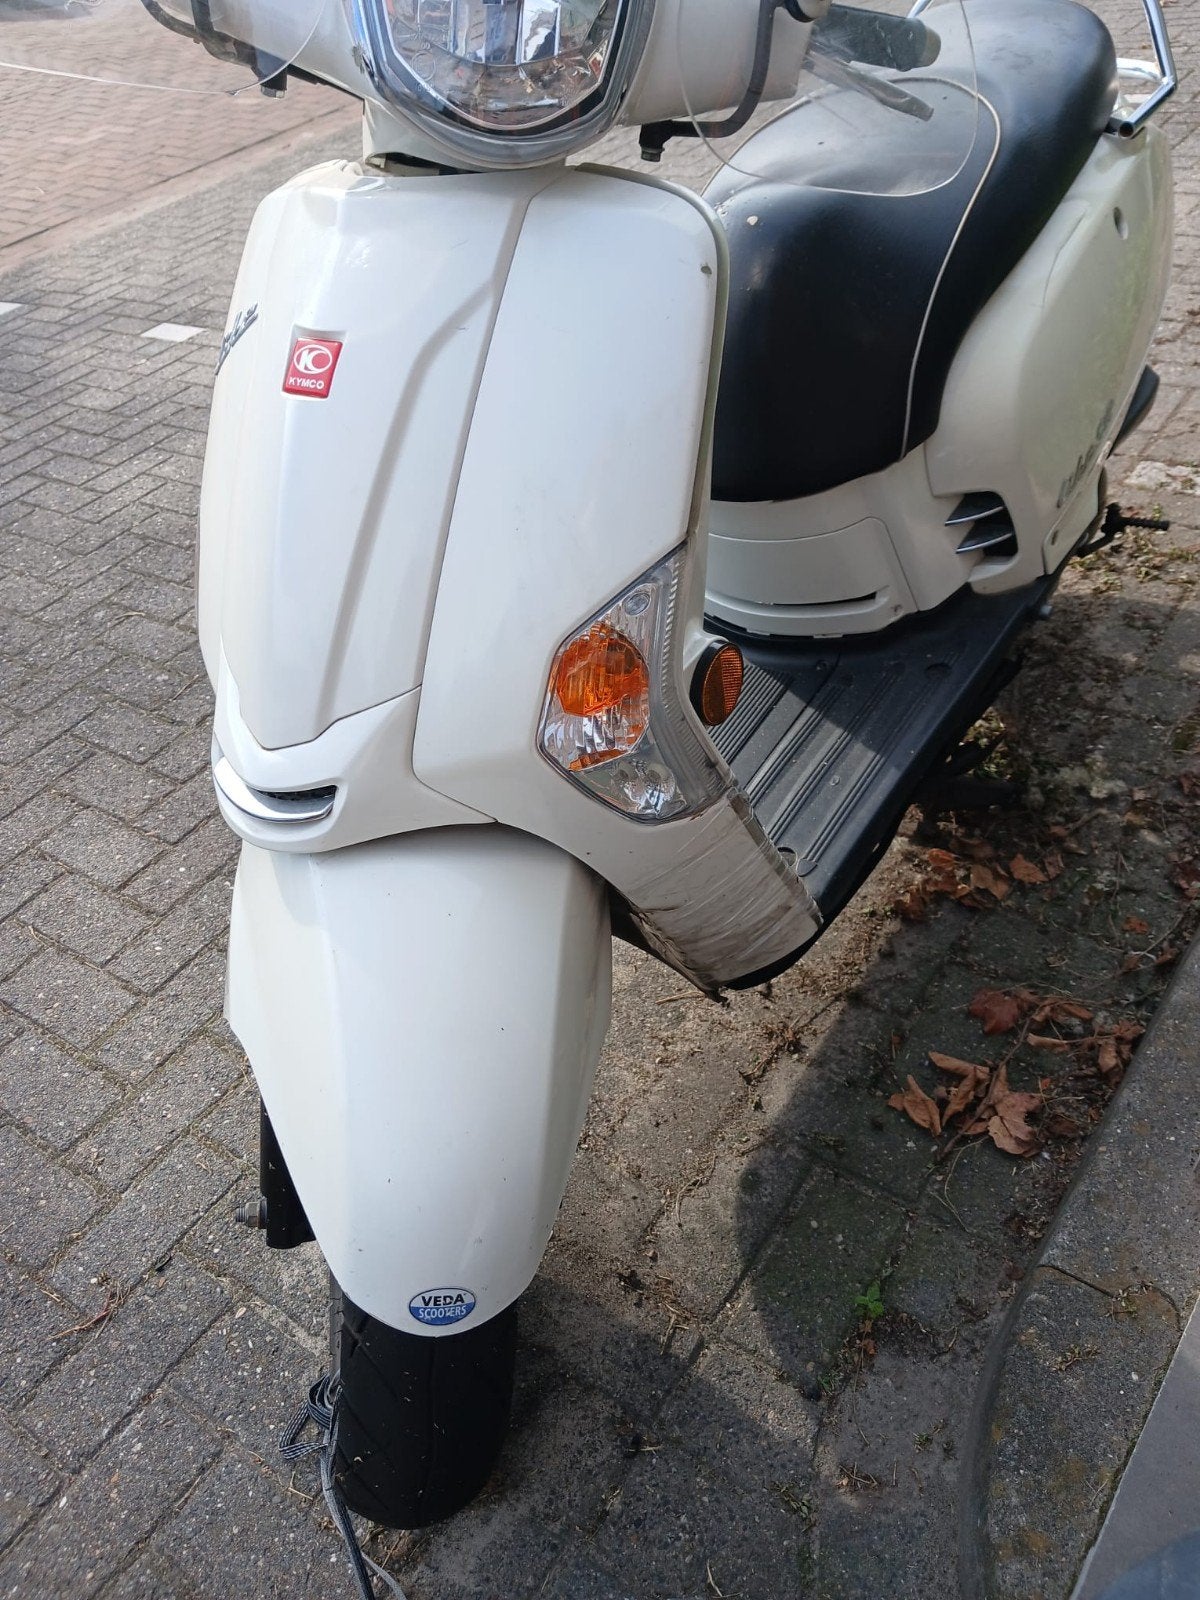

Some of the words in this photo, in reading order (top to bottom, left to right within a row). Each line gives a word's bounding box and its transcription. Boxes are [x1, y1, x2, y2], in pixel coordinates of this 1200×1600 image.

[288, 376, 325, 390] KYMCO
[421, 1293, 465, 1307] VEDA
[418, 1305, 467, 1319] SCOOTERS
